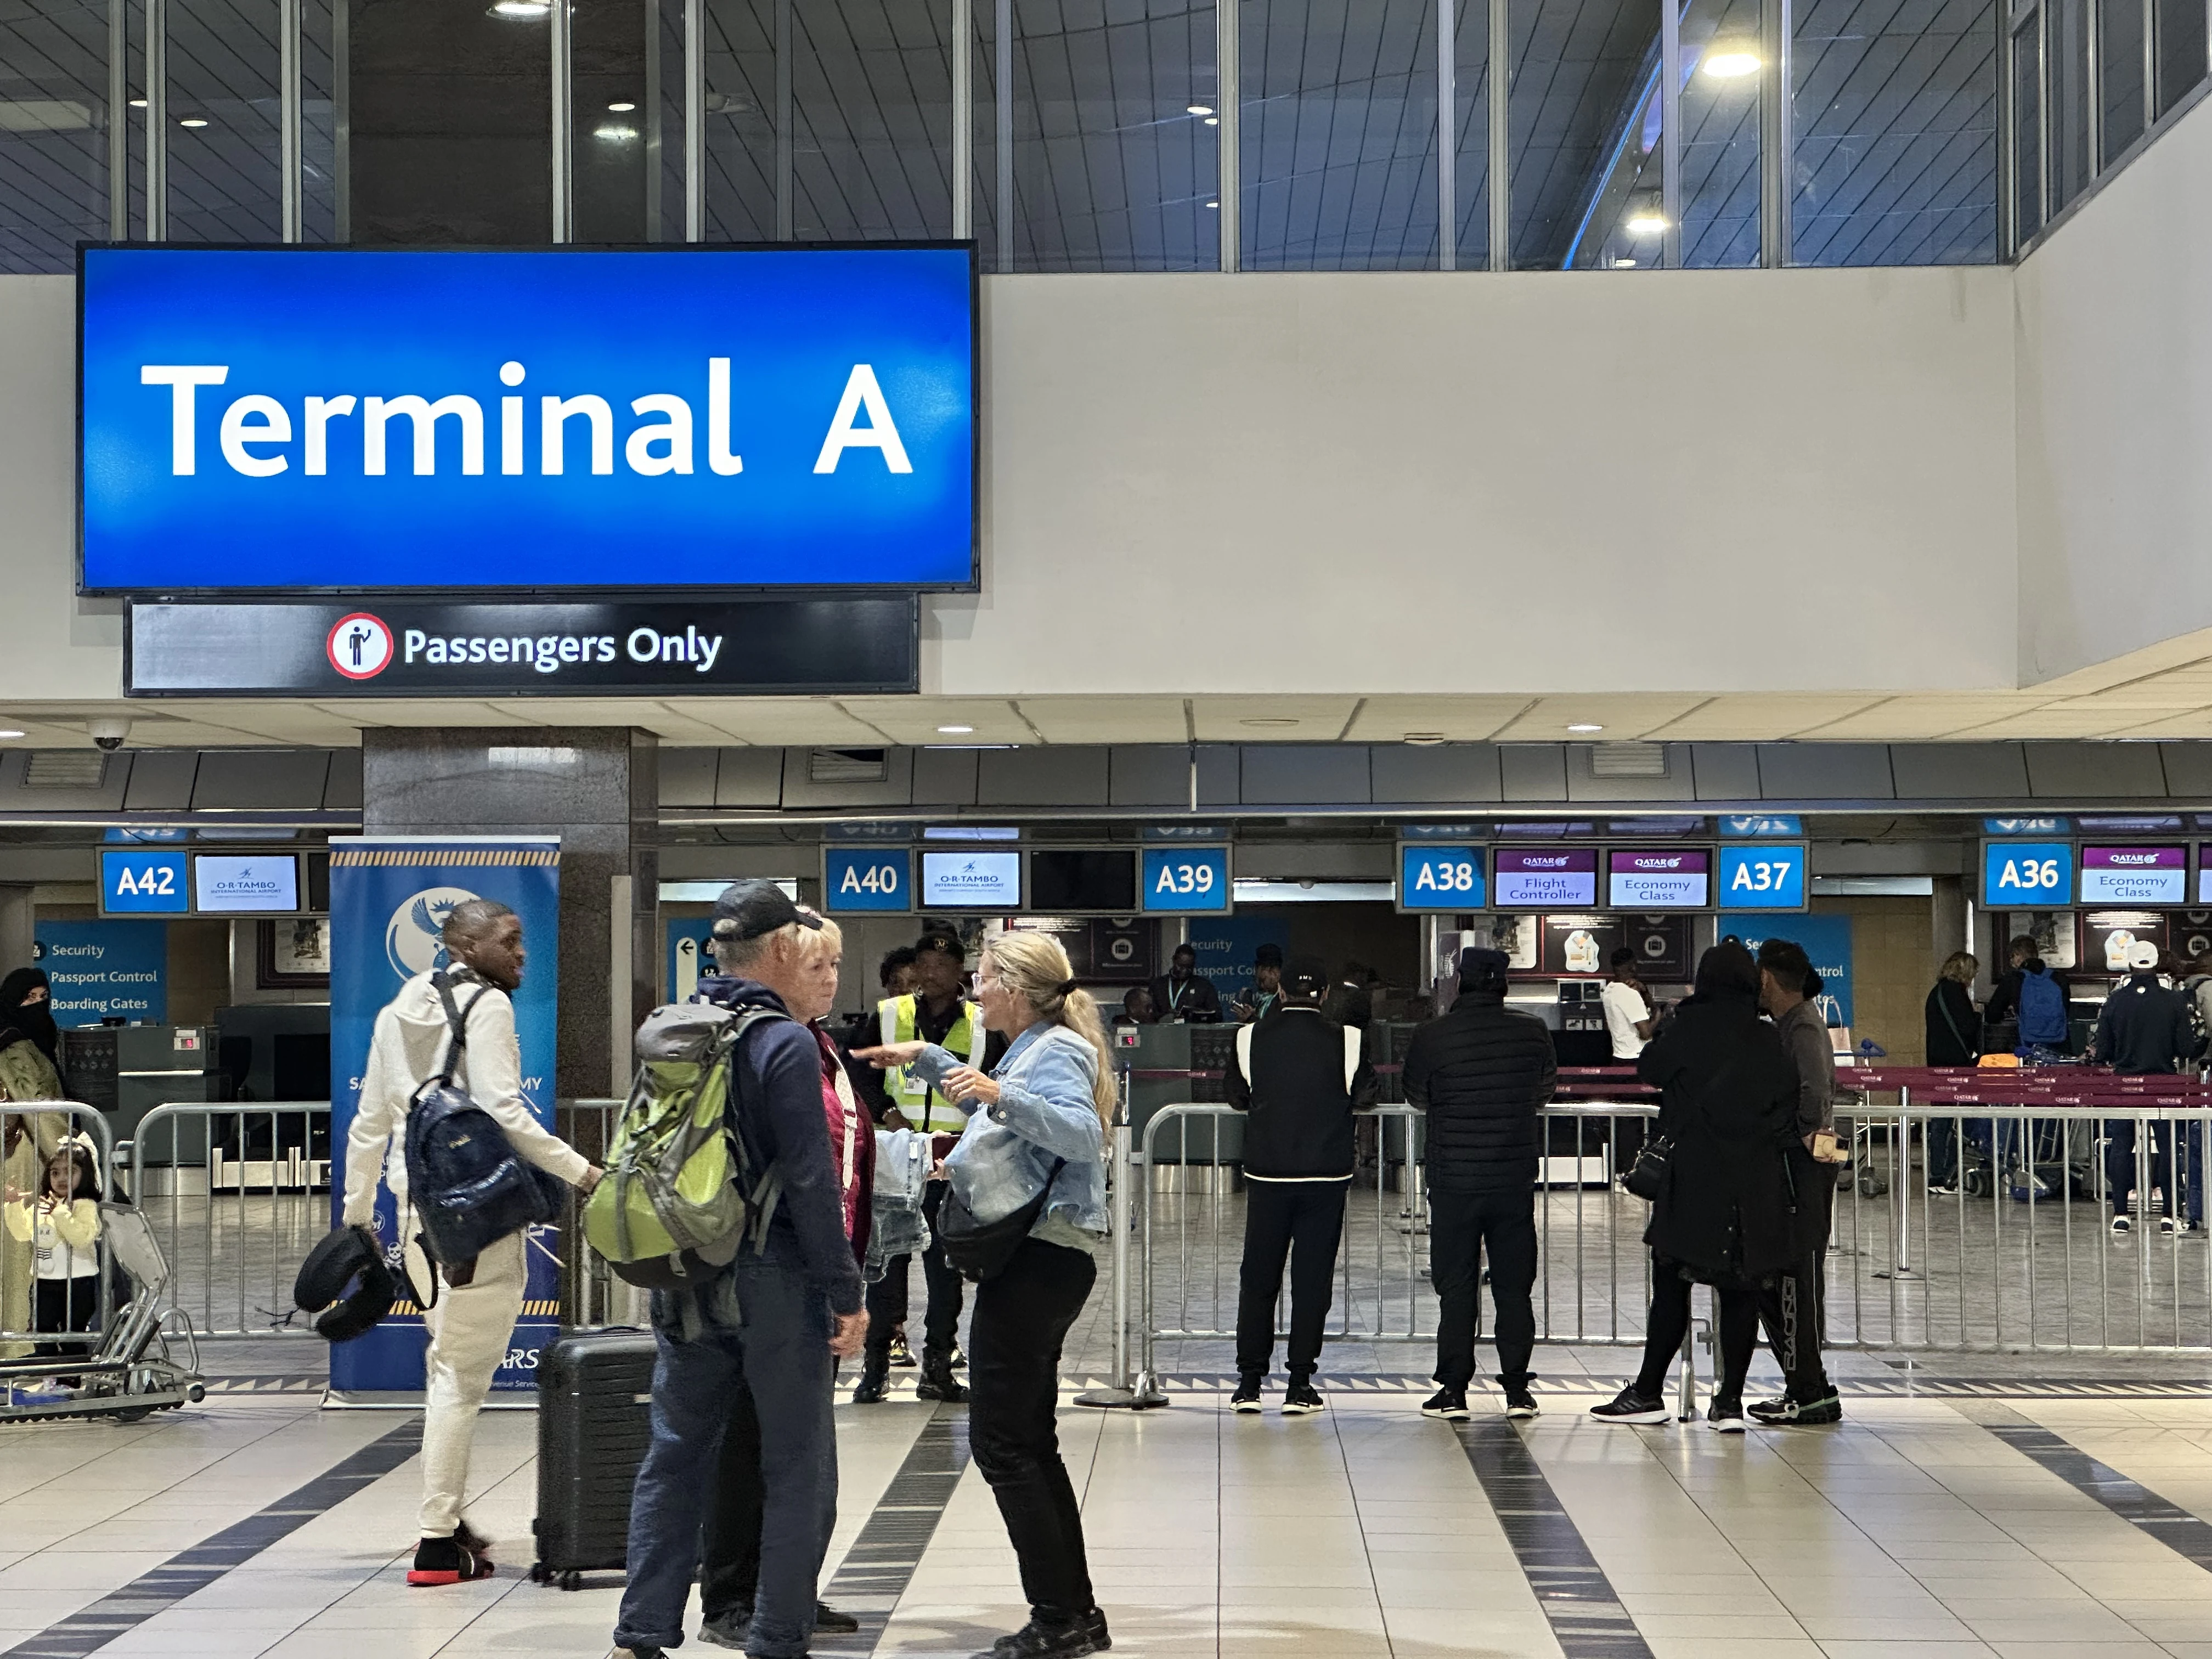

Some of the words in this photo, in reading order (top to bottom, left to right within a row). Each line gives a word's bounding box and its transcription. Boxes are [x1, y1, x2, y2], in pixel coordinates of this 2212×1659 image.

[142, 358, 742, 477] Terminal
[814, 364, 913, 473] A
[405, 629, 616, 673] Passengers
[627, 625, 723, 672] Only
[1522, 857, 1555, 865] QATAR
[1635, 858, 1667, 866] QATAR
[2109, 854, 2143, 862] QATAR
[840, 866, 898, 893] A40
[1155, 865, 1214, 893] A39
[1415, 862, 1472, 890] A38
[1731, 862, 1791, 890] A37
[1999, 859, 2058, 888] A36
[117, 867, 175, 895] A42
[1525, 878, 1567, 890] Flight
[1624, 879, 1690, 891] Economy
[2100, 876, 2167, 887] Economy
[1510, 889, 1581, 899] Controller
[1639, 890, 1675, 900] Class
[2115, 887, 2152, 897] Class
[52, 944, 105, 958] Security
[1190, 939, 1233, 953] ecurity
[1193, 965, 1234, 978] assport
[1815, 964, 1843, 977] ntrol
[51, 970, 106, 986] Passport
[109, 970, 157, 982] Control
[51, 997, 108, 1013] Boarding
[110, 998, 148, 1009] Gates
[503, 1348, 540, 1369] ARS
